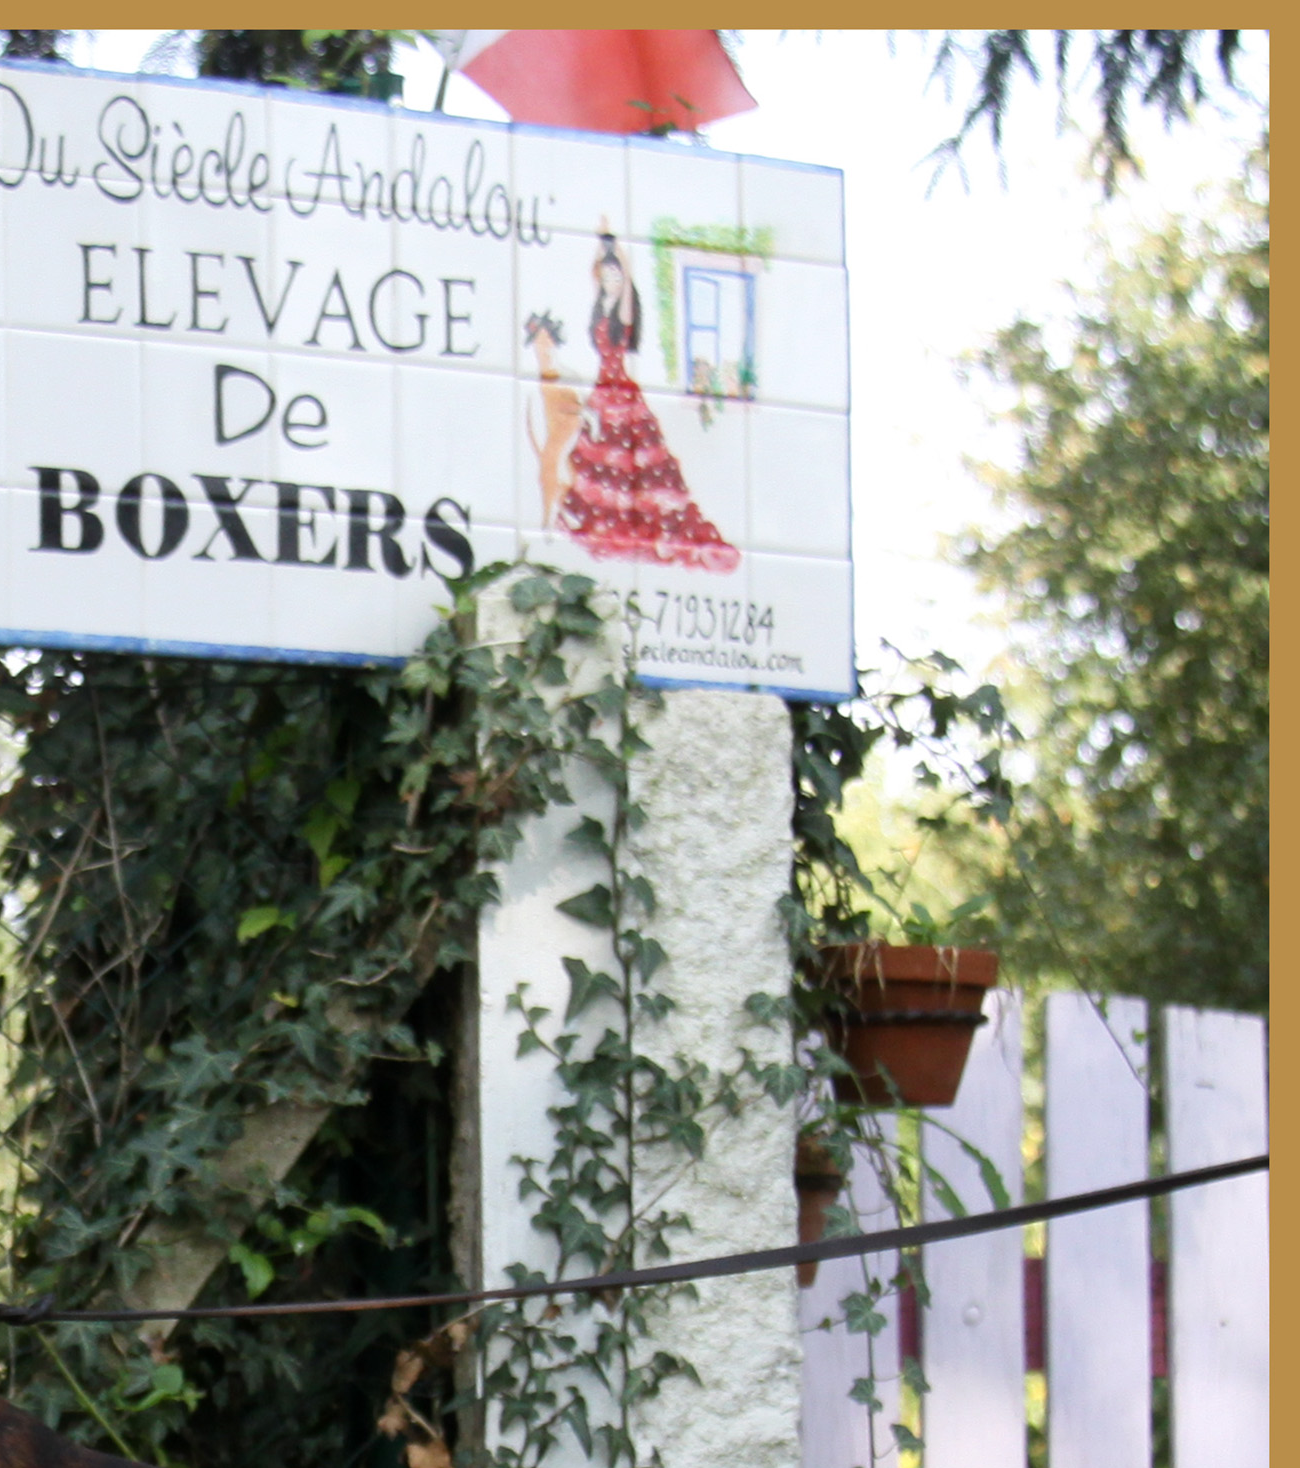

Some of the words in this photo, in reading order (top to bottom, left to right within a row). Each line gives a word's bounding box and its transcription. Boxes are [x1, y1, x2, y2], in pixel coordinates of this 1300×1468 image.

[94, 95, 273, 213] Siècle
[76, 242, 481, 358] ELEVAGE
[212, 363, 329, 449] De
[28, 464, 476, 580] BOXERS
